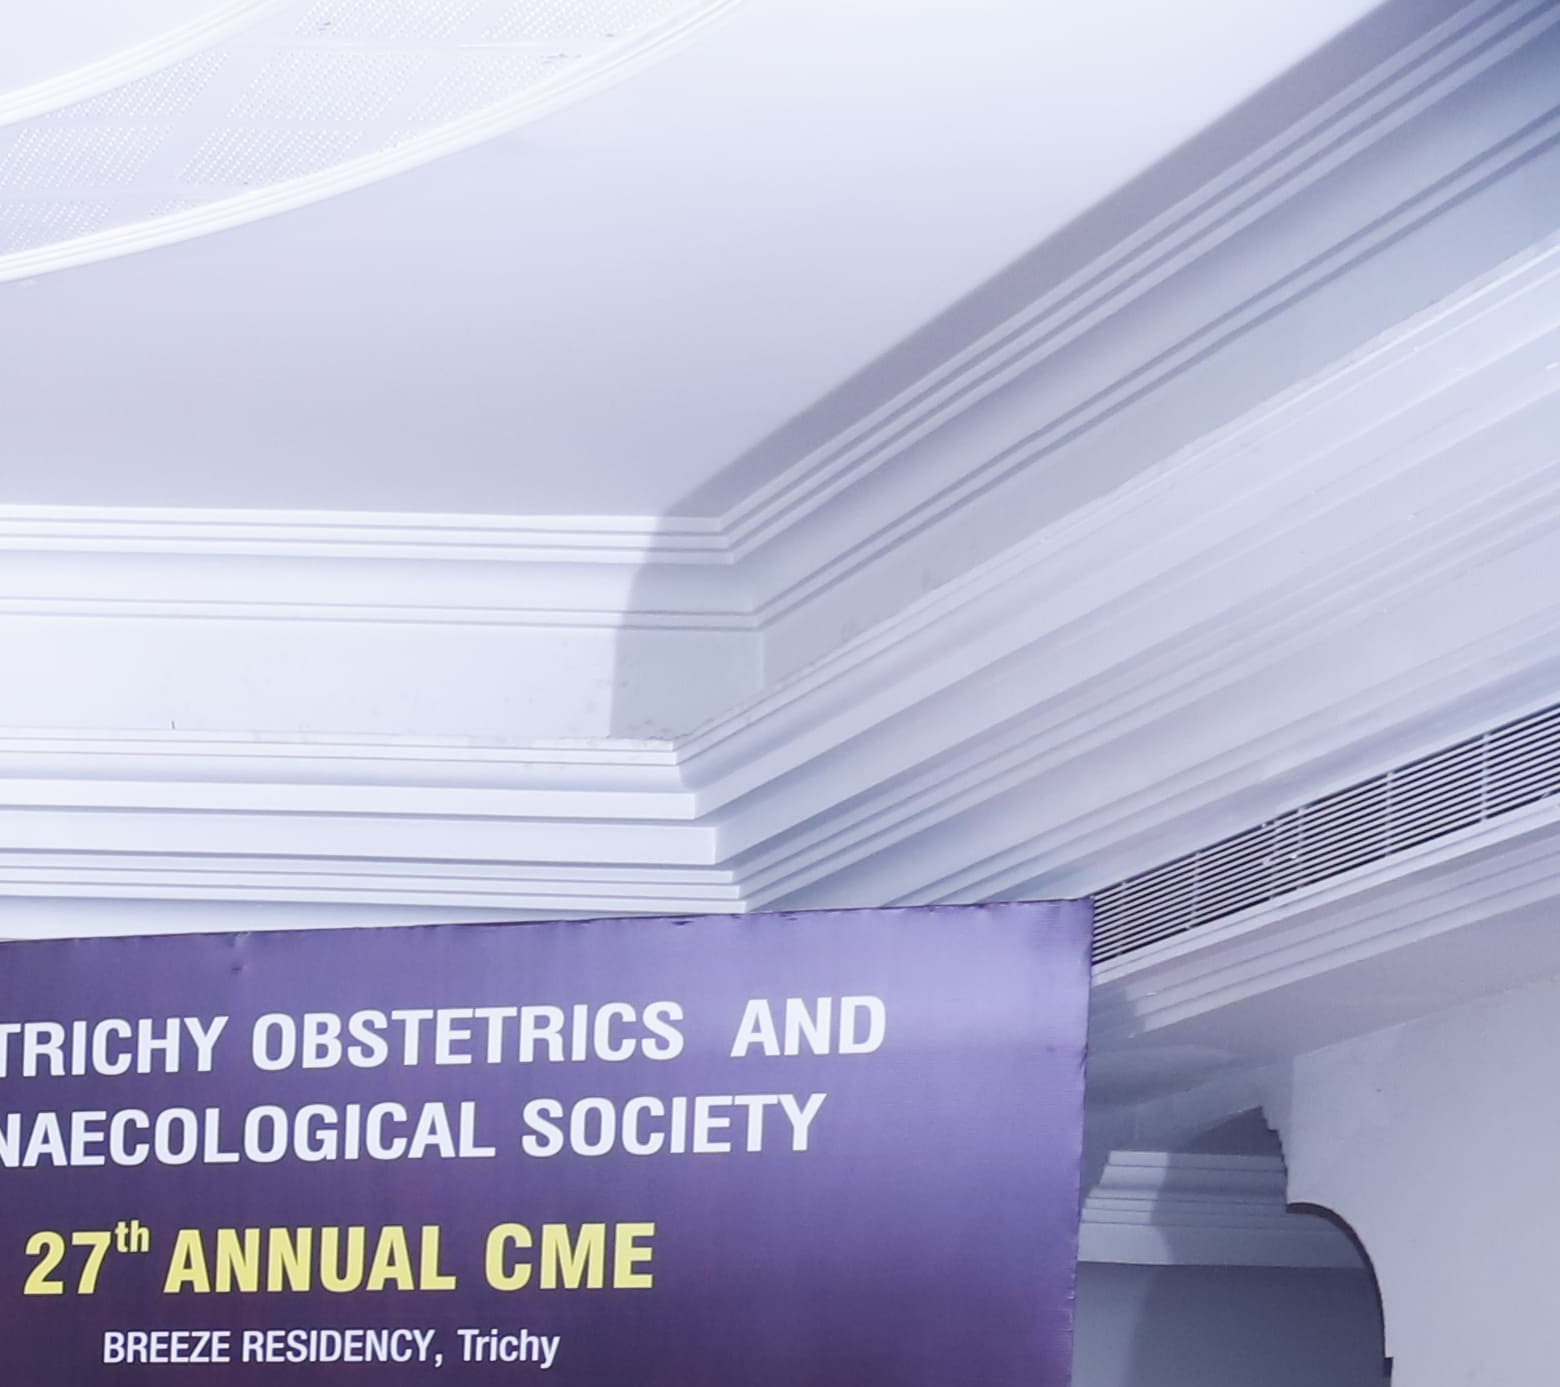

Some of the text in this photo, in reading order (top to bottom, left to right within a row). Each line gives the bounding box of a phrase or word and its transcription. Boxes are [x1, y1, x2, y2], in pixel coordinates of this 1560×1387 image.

[251, 1000, 685, 1070] OBSTETRICS
[731, 994, 886, 1059] AND
[521, 1092, 827, 1158] SOCIETY
[23, 1218, 656, 1295] 27th ANNUAL CME
[102, 1327, 561, 1370] BREEZE RESIDENCY, Trichy
